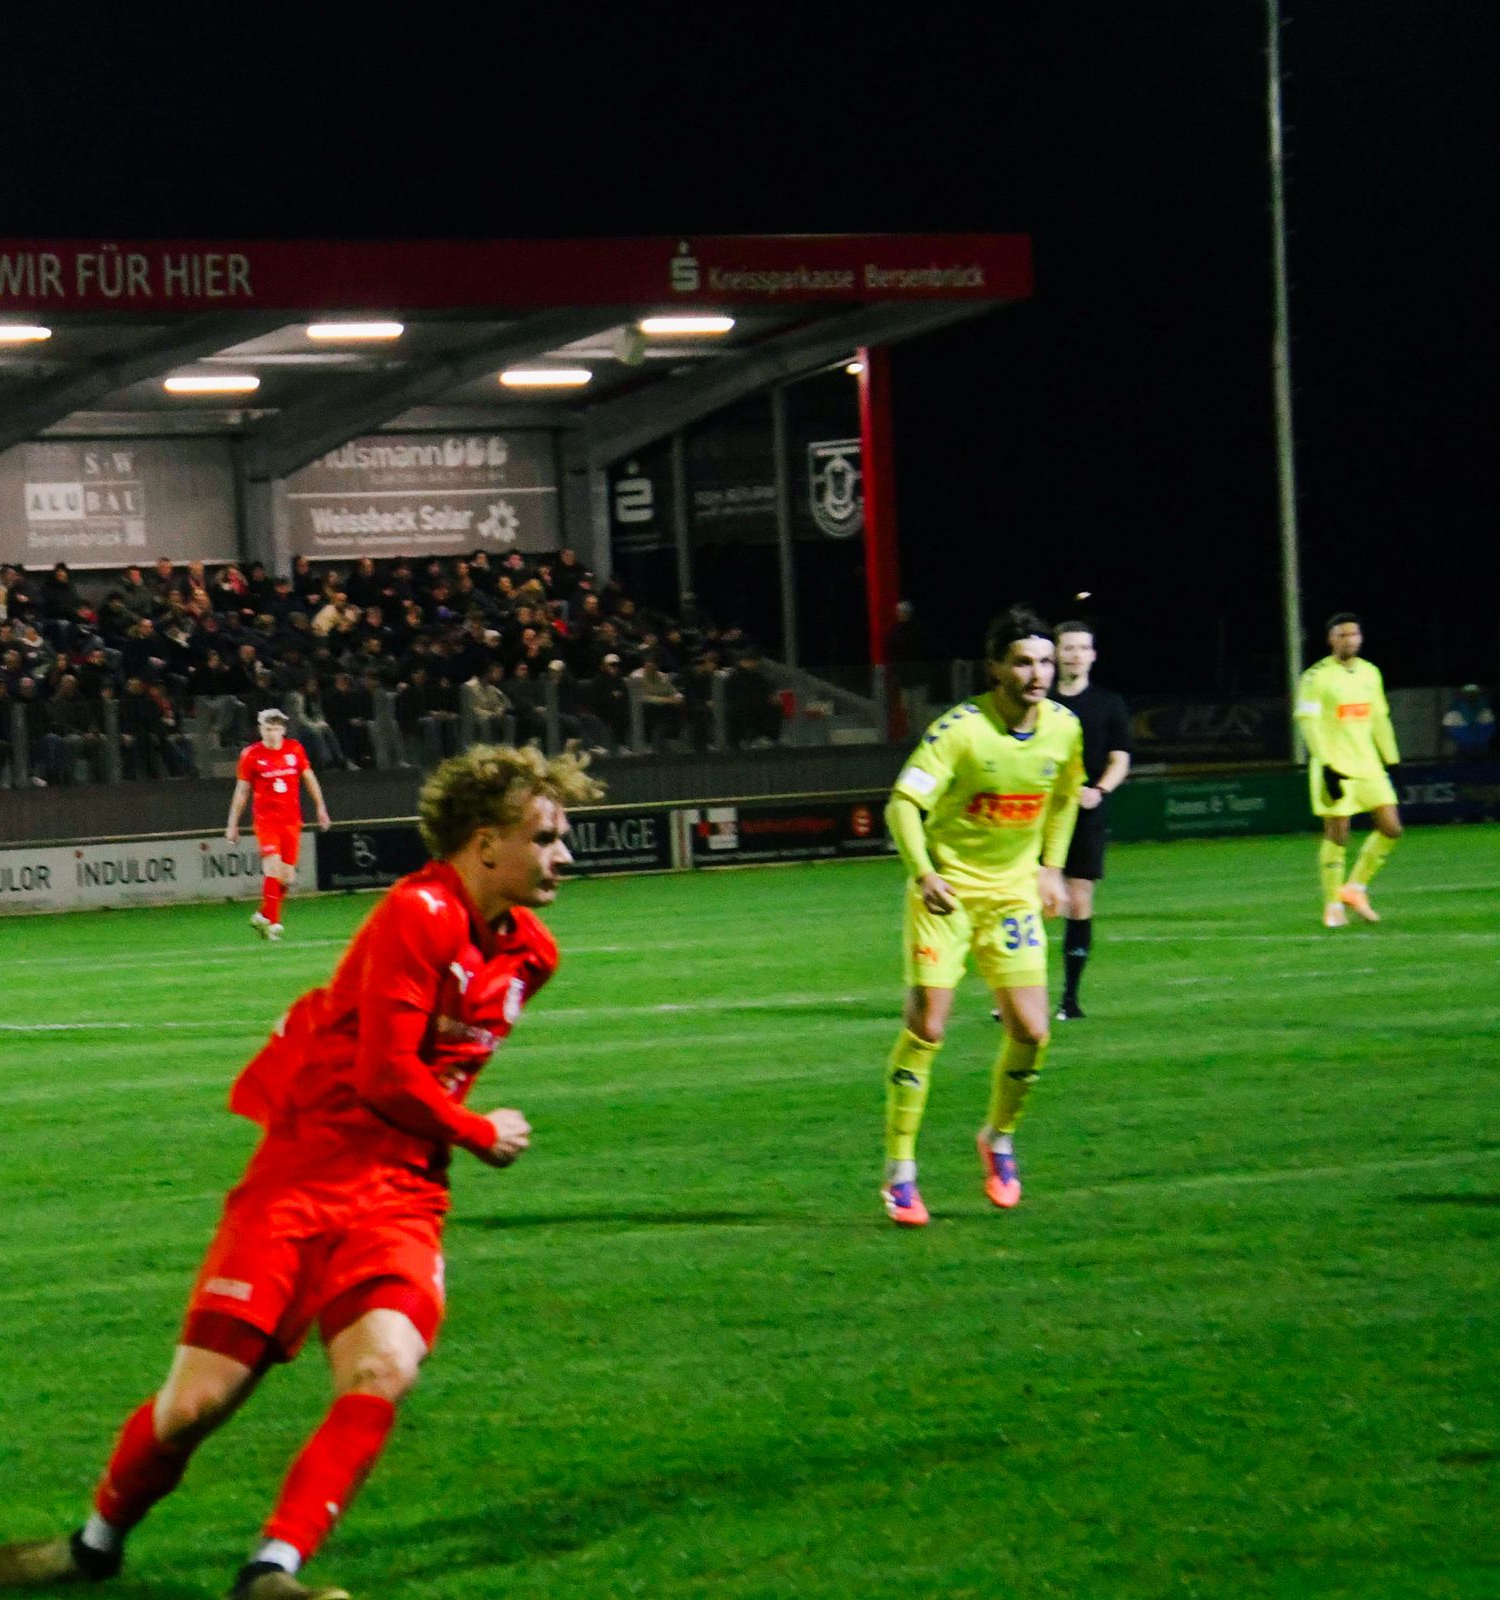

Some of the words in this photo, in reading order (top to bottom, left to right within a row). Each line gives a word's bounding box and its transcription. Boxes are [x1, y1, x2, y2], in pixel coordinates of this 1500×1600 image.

[76, 243, 152, 298] FÜR
[164, 252, 253, 298] HIER
[707, 264, 856, 294] Kreissparkasse
[864, 263, 985, 289] Bersenbrück
[419, 503, 474, 531] Solar
[1002, 914, 1040, 950] 32
